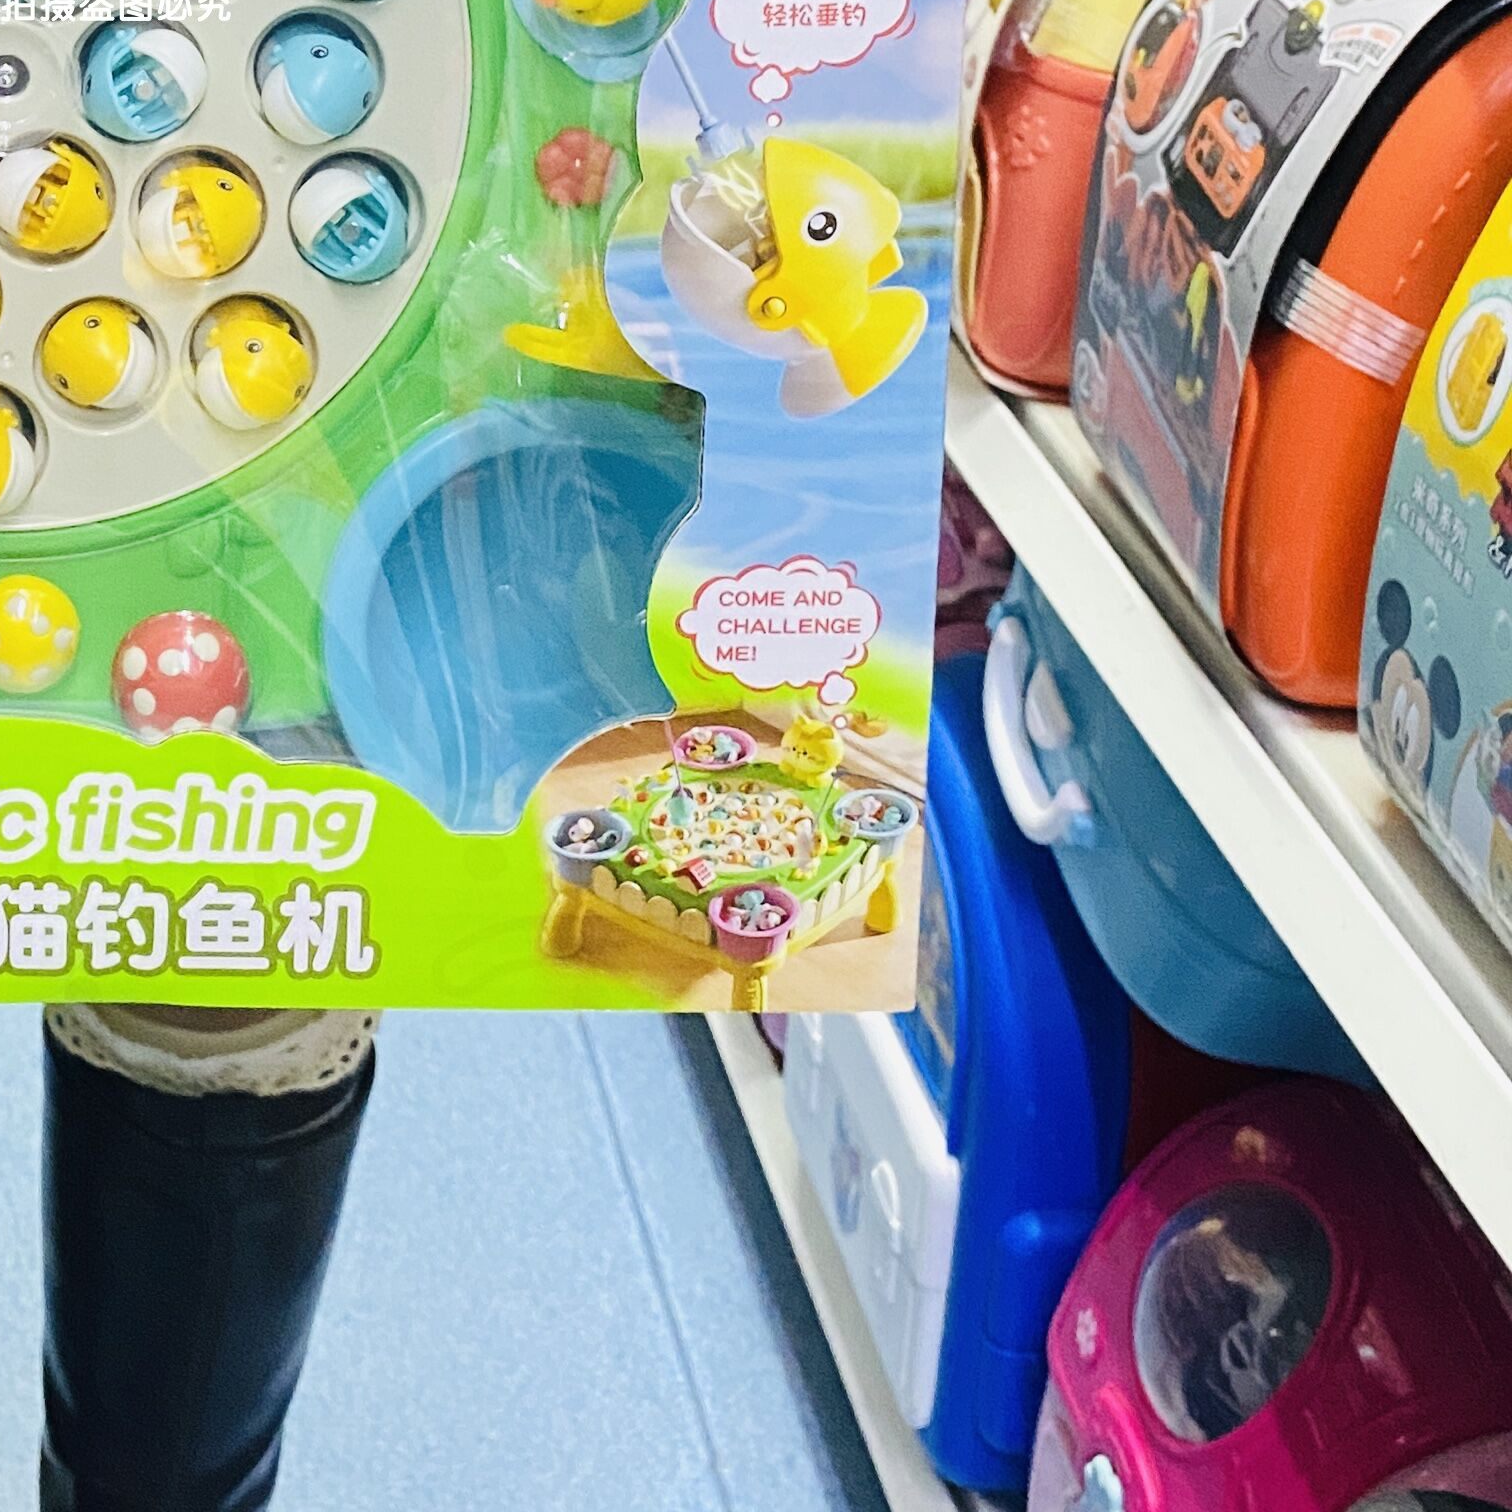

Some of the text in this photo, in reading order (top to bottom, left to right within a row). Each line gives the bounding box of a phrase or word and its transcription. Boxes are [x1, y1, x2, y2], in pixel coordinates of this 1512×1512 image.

[762, 2, 867, 28] 轻松垂钓
[718, 590, 843, 608] COME AND
[717, 618, 862, 635] CHALLENGE
[715, 645, 758, 663] ME!
[56, 775, 374, 872] fishing
